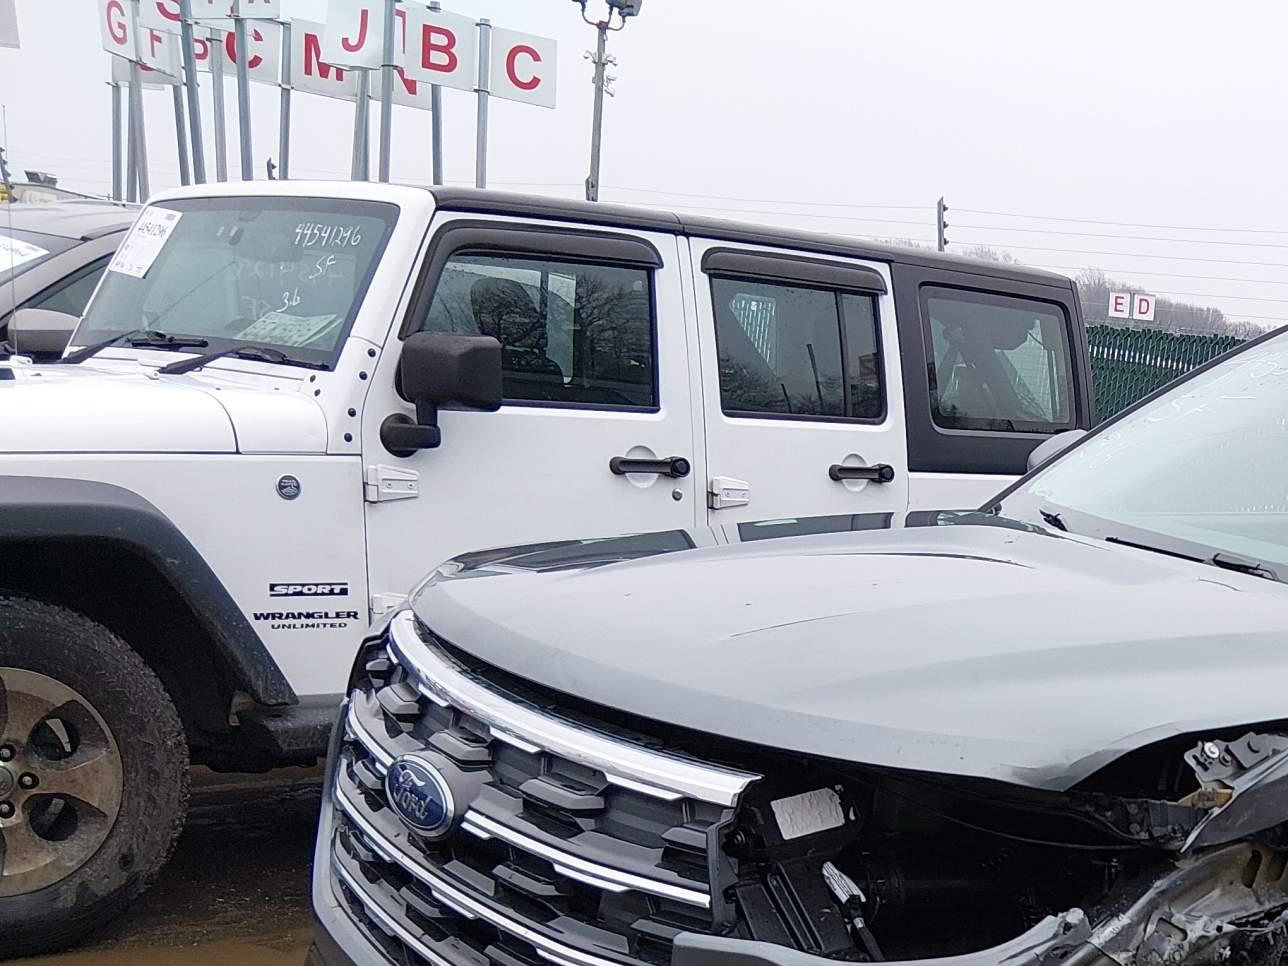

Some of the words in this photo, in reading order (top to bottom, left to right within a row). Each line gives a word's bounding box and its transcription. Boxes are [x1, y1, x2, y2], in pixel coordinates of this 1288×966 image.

[106, 0, 128, 46] G
[341, 9, 369, 53] J
[421, 23, 458, 73] B
[505, 44, 542, 91] C
[1114, 295, 1125, 313] E
[1138, 298, 1150, 315] D
[272, 584, 348, 596] SPORT
[253, 611, 361, 621] WRANGLER
[271, 622, 348, 630] UNLIMITED
[393, 769, 430, 820] Ford
